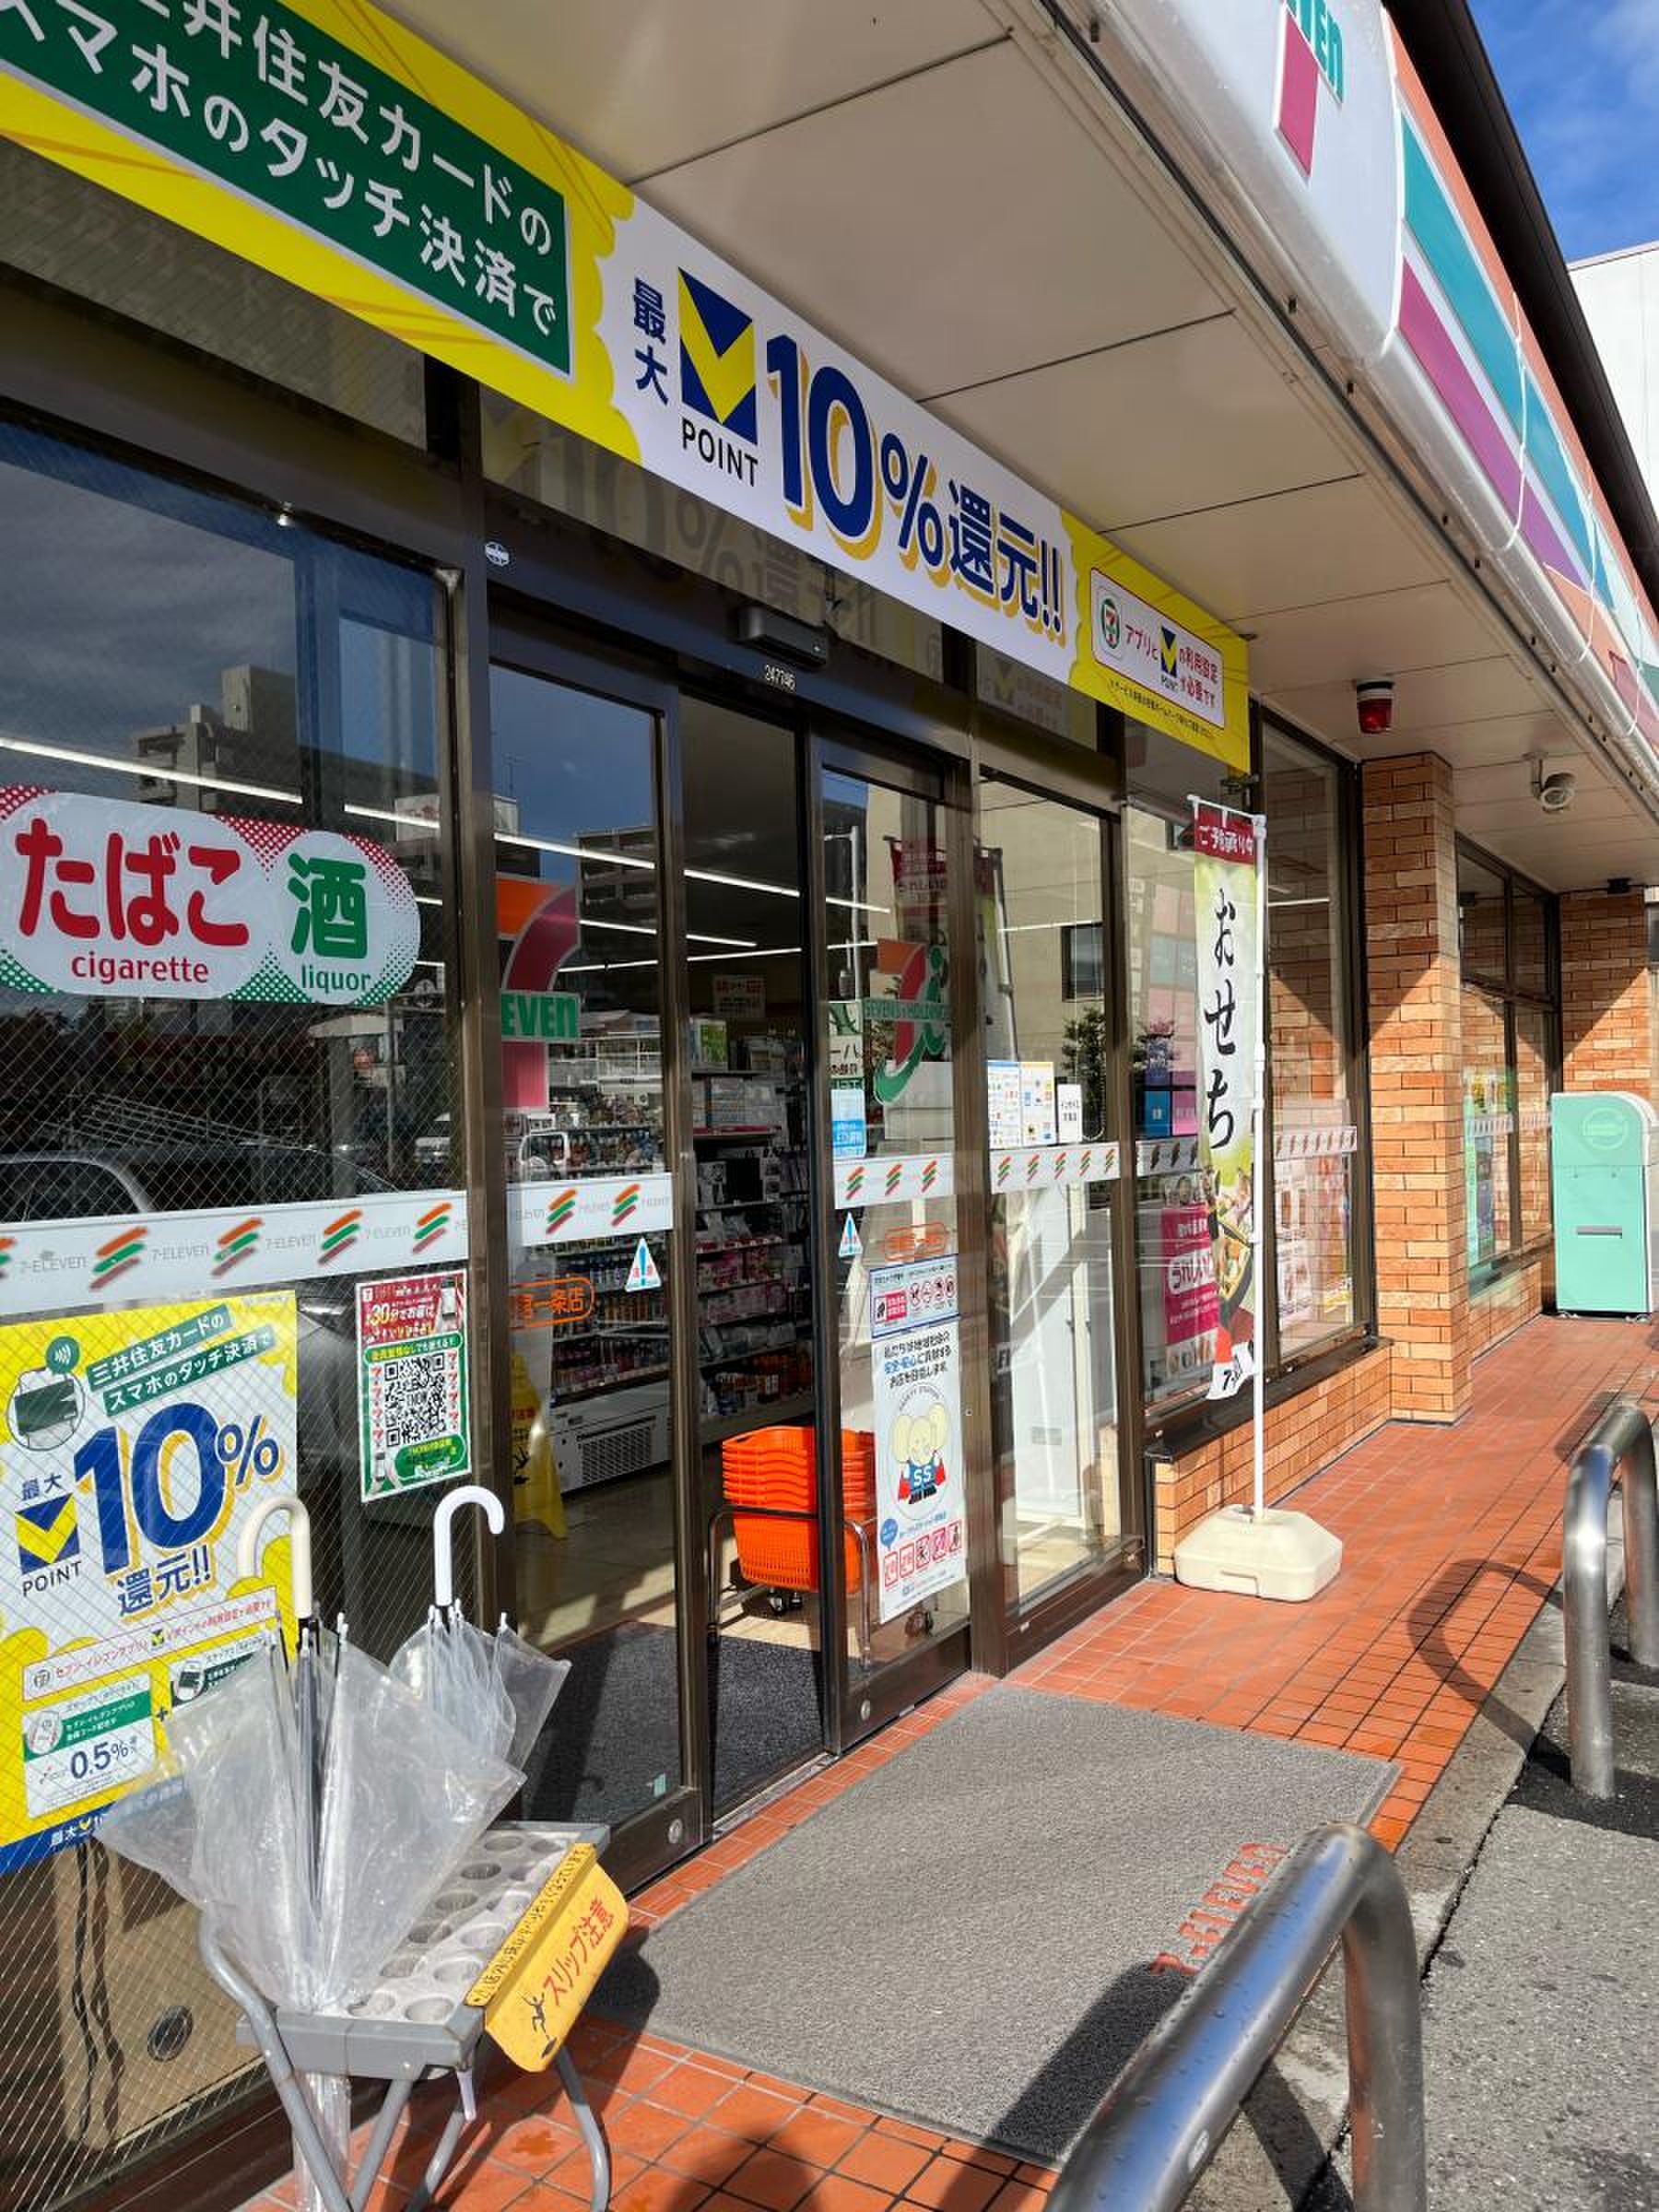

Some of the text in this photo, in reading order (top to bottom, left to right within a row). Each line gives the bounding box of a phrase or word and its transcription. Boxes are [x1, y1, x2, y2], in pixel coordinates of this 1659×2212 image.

[141, 0, 552, 256] 井住友カードの
[632, 277, 669, 406] 最大
[682, 417, 759, 488] POINT
[15, 818, 250, 947] たばこ
[288, 852, 368, 959] 酒
[71, 951, 209, 983] cigarette
[300, 964, 371, 994] liquor
[1205, 888, 1237, 1149] おせち
[91, 1312, 226, 1383] 三井住友カードの
[109, 1333, 273, 1411] スマホのタッチ決済で
[21, 1473, 64, 1502] 最大
[74, 1400, 280, 1574] 10%
[22, 1561, 83, 1597] POINT
[117, 1545, 211, 1618] 還元!!
[543, 1897, 615, 2006] スリップ注意
